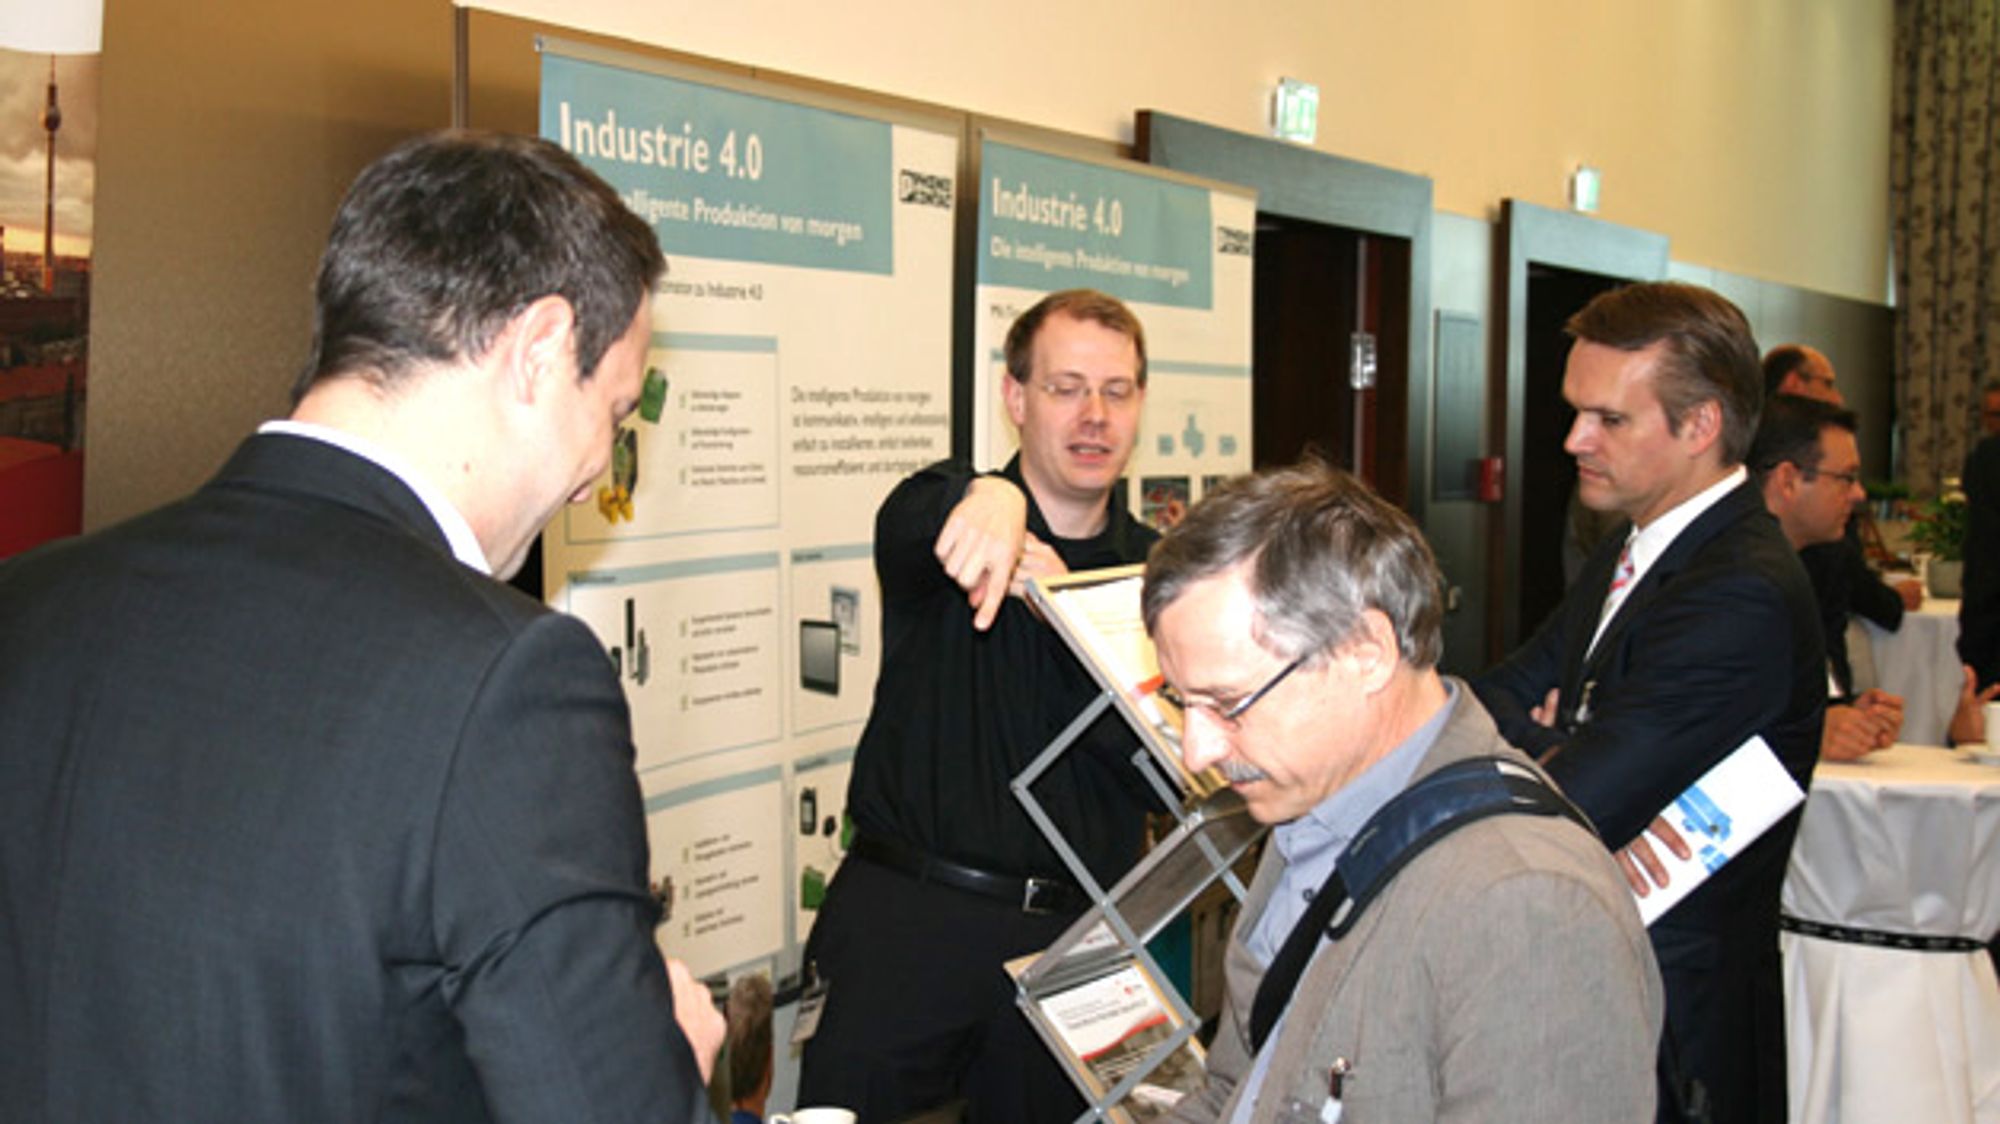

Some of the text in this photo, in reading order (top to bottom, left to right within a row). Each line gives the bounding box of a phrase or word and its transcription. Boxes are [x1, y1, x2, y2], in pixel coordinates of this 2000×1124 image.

[560, 102, 763, 180] Industrie 4.0
[693, 197, 778, 231] Produktion
[780, 213, 804, 234] von
[807, 217, 863, 247] morgen
[992, 177, 1087, 231] Industrie
[1093, 197, 1123, 237] 4.0
[990, 235, 1011, 258] Die
